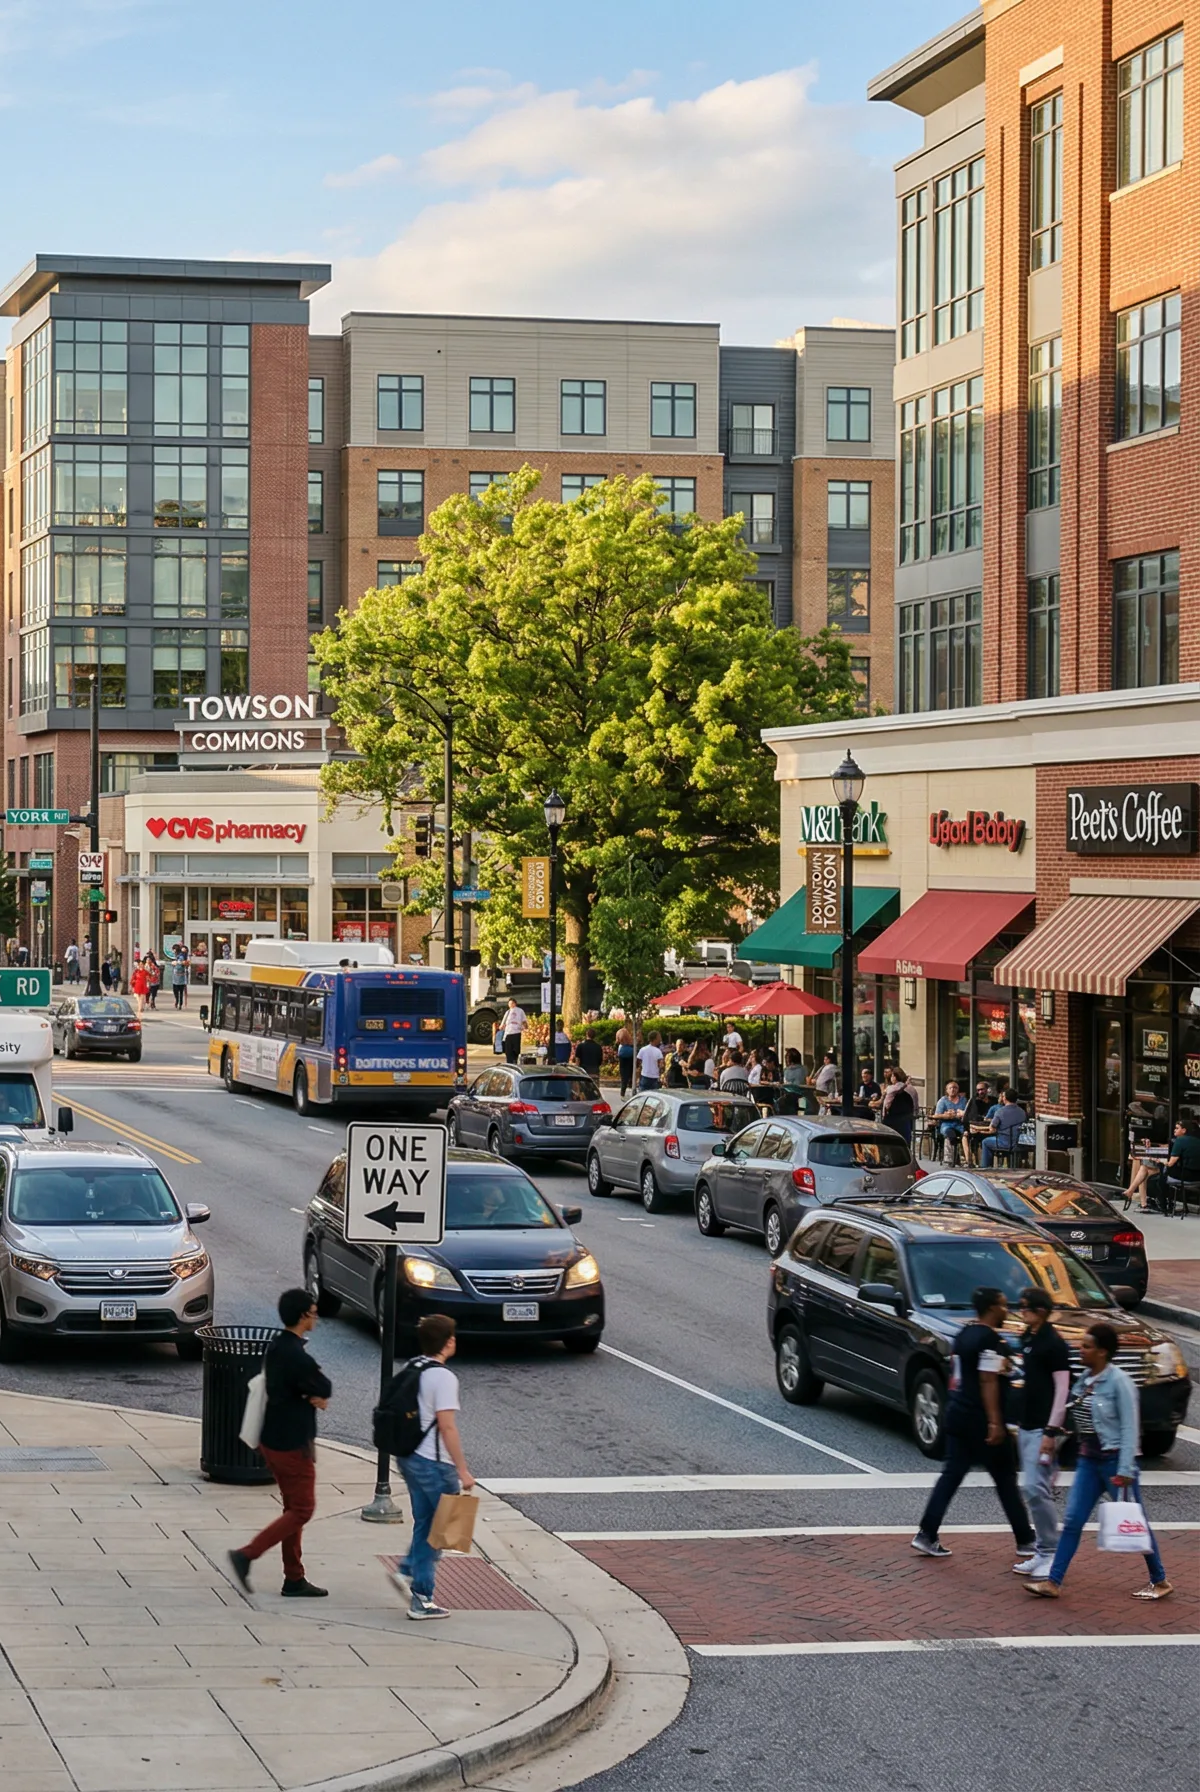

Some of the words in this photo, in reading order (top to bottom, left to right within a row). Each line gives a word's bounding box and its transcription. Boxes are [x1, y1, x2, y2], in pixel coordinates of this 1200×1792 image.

[183, 694, 315, 720] TOWSON
[192, 731, 305, 750] COMMONS
[167, 817, 214, 839] CVS
[215, 820, 307, 843] pharmacy
[800, 805, 841, 842] M&T
[1068, 793, 1119, 842] Peet's
[1122, 791, 1183, 846] Coffee
[823, 854, 837, 928] TOWSON
[16, 977, 40, 996] RD
[365, 1134, 427, 1162] ONE
[363, 1167, 430, 1196] WAY
